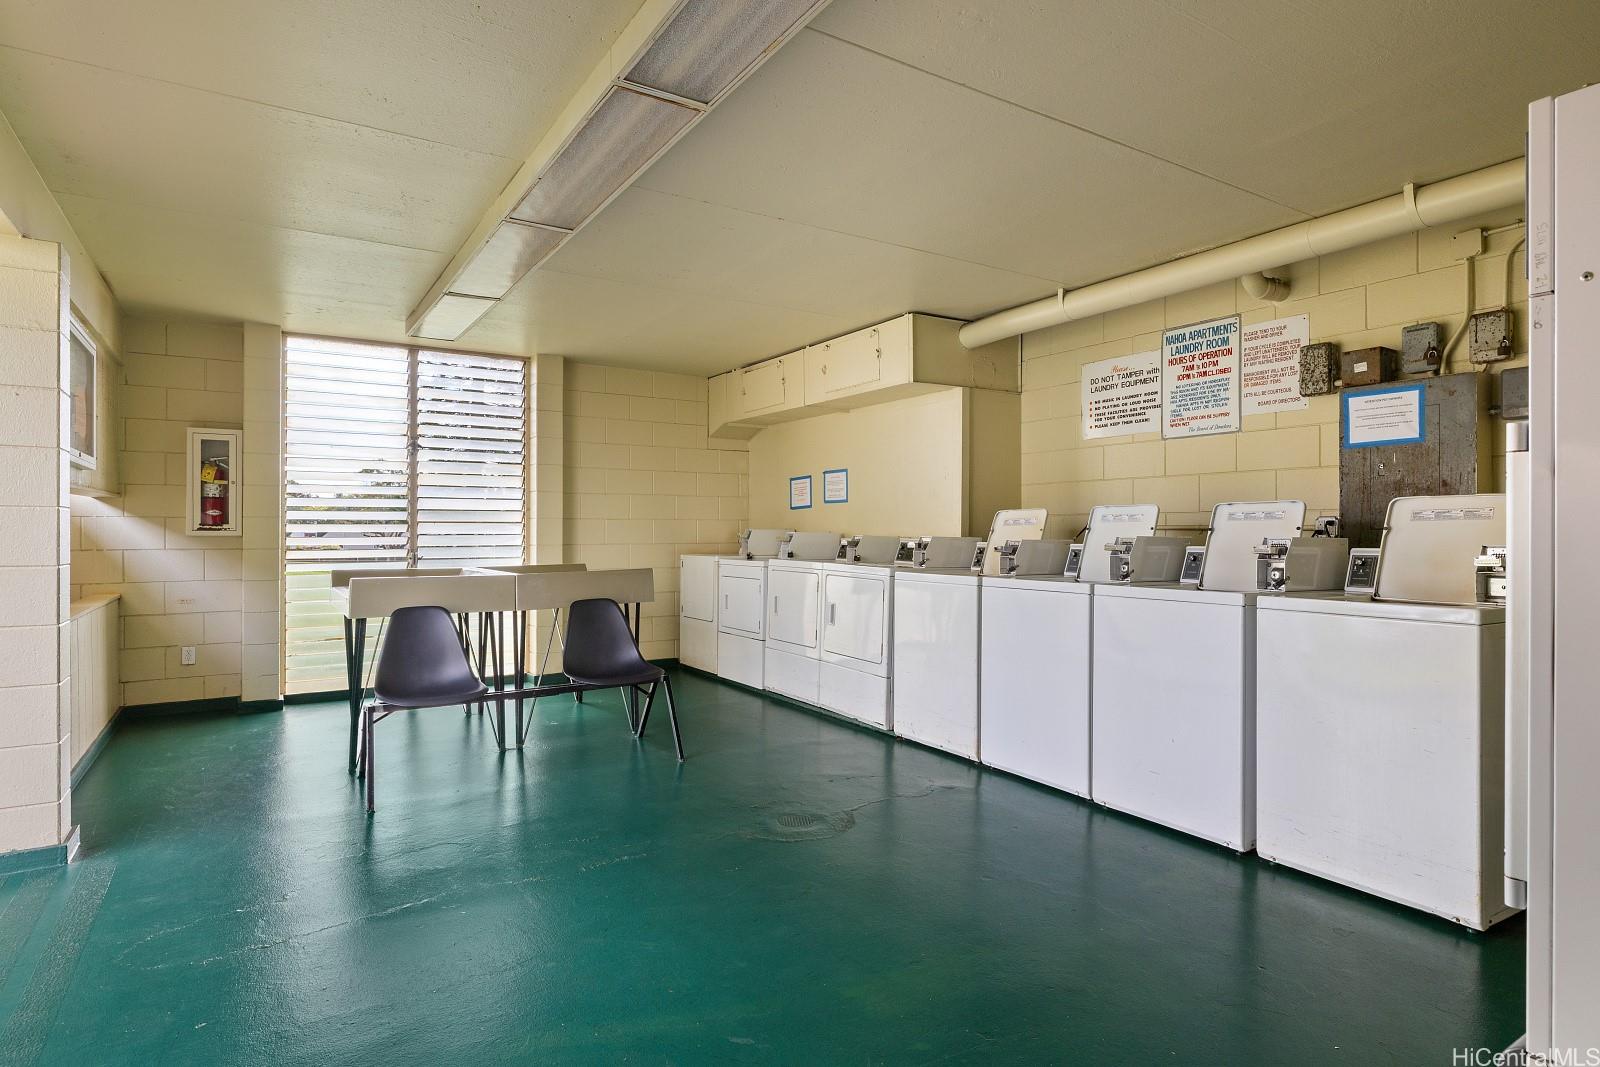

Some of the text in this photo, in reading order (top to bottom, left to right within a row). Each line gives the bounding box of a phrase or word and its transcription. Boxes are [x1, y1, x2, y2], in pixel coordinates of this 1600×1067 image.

[1166, 322, 1238, 346] NAHOA APARTMENTS
[1171, 336, 1230, 357] LAUNDRY ROOM
[1168, 347, 1232, 367] HOURS OF OPERATION
[1101, 374, 1114, 382] NOT
[1117, 370, 1144, 380] TAMPER
[1146, 366, 1160, 375] with
[1182, 364, 1195, 373] 7AM
[1208, 367, 1232, 376] CLOSED
[1244, 369, 1270, 377] MANAGEMENT
[1090, 376, 1159, 394] LAUNDRY EQUIPMENT
[1244, 374, 1270, 382] RESPONSIBLE
